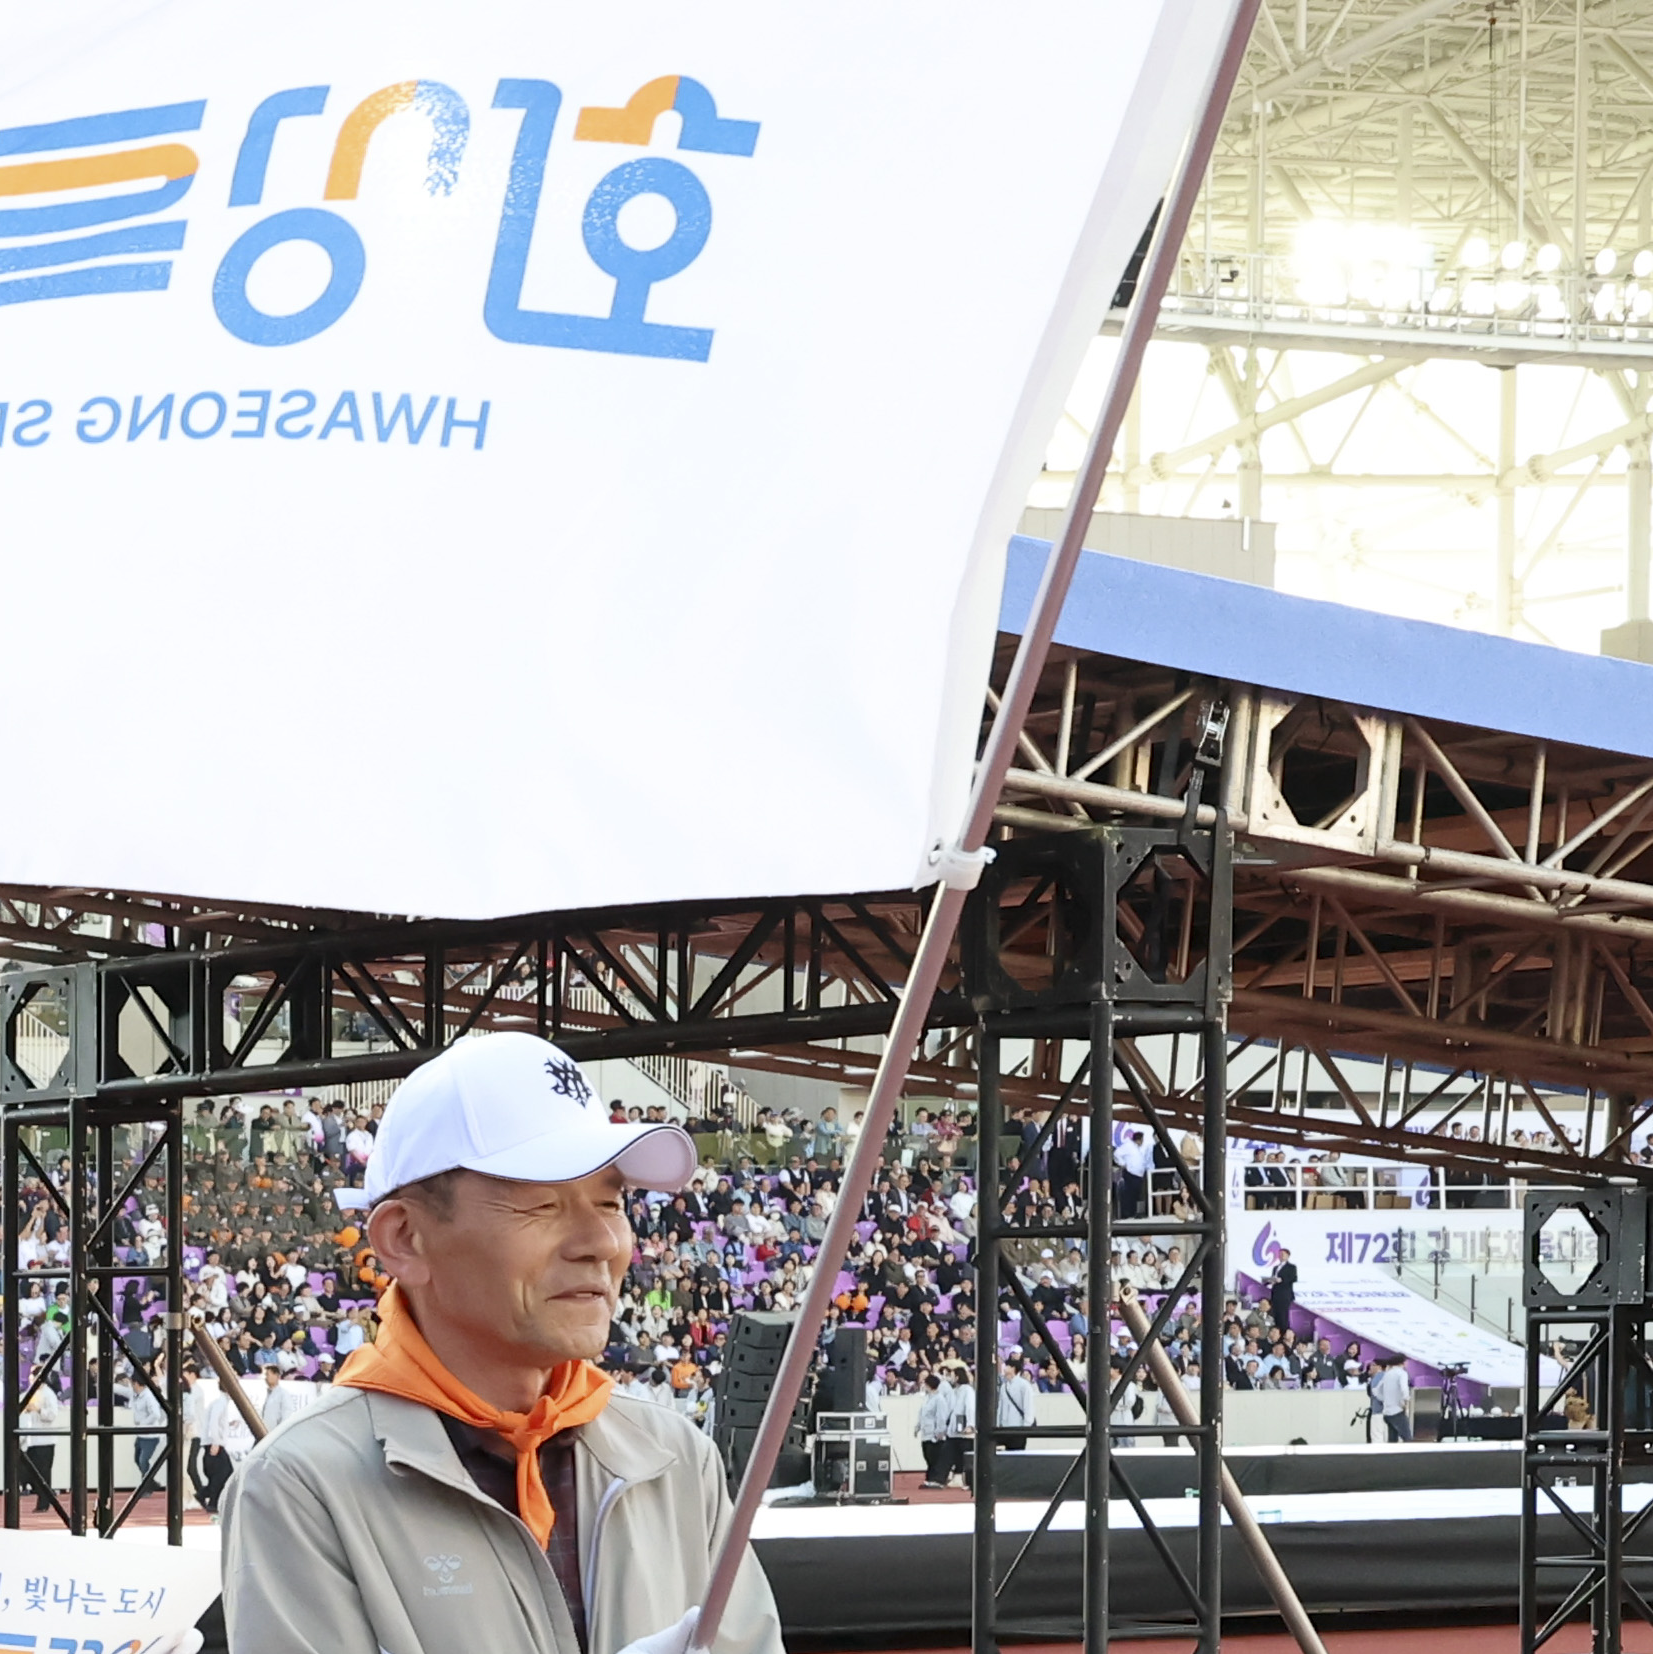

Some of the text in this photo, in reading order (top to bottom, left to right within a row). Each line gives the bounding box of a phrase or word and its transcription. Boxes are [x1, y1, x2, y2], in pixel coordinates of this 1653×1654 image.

[1326, 1231, 1415, 1263] 제72회
[25, 1577, 107, 1616] 빛나는
[113, 1586, 166, 1619] 도시
